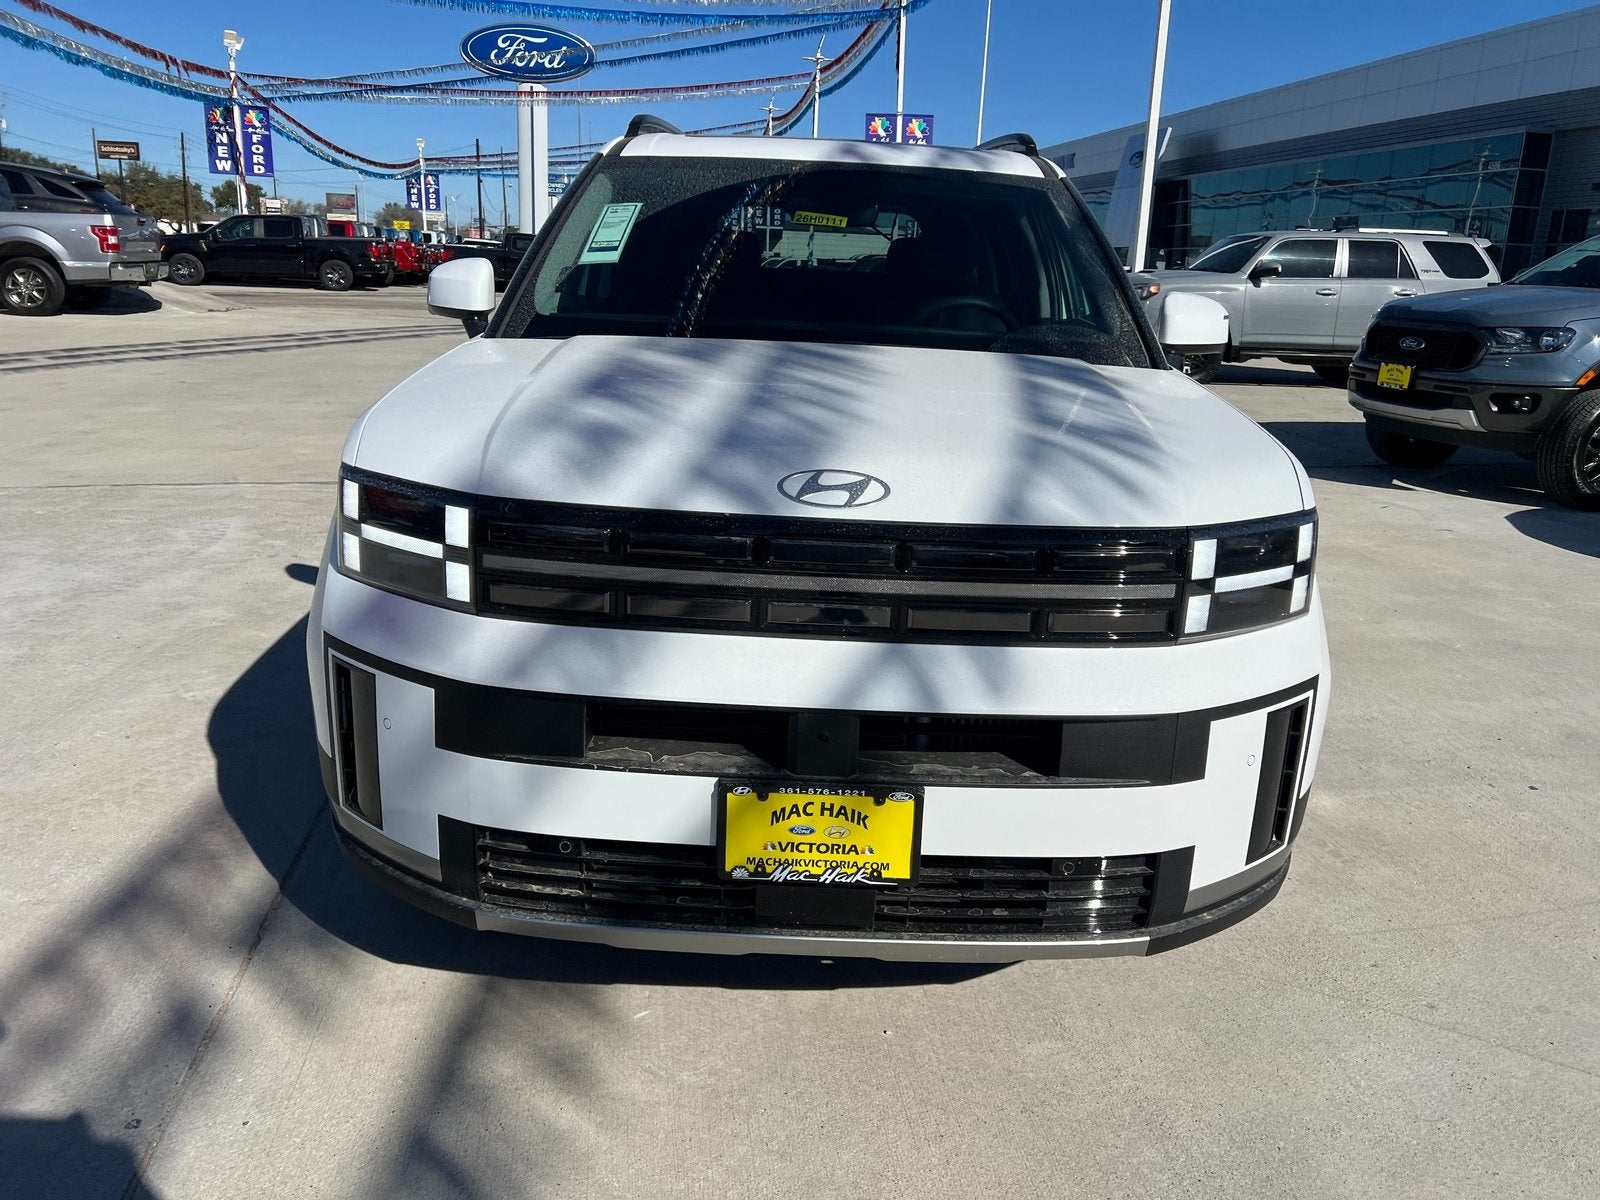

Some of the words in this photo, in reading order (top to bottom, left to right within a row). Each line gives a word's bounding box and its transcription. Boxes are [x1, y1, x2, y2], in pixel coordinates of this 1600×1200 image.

[490, 33, 568, 69] Ford
[214, 132, 232, 172] NEW
[251, 134, 265, 174] FORD
[410, 187, 419, 209] NEW
[428, 187, 437, 209] FORD
[795, 213, 843, 227] 26H0111
[779, 787, 866, 797] 361-576-1221
[770, 801, 814, 826] MAC
[820, 801, 869, 831] HAIK
[793, 827, 811, 836] Ford
[778, 841, 859, 855] VICTORIA
[746, 856, 890, 871] MACHAIKVICTORIA.COM
[768, 864, 817, 882] Mac
[819, 866, 880, 885] Haik
